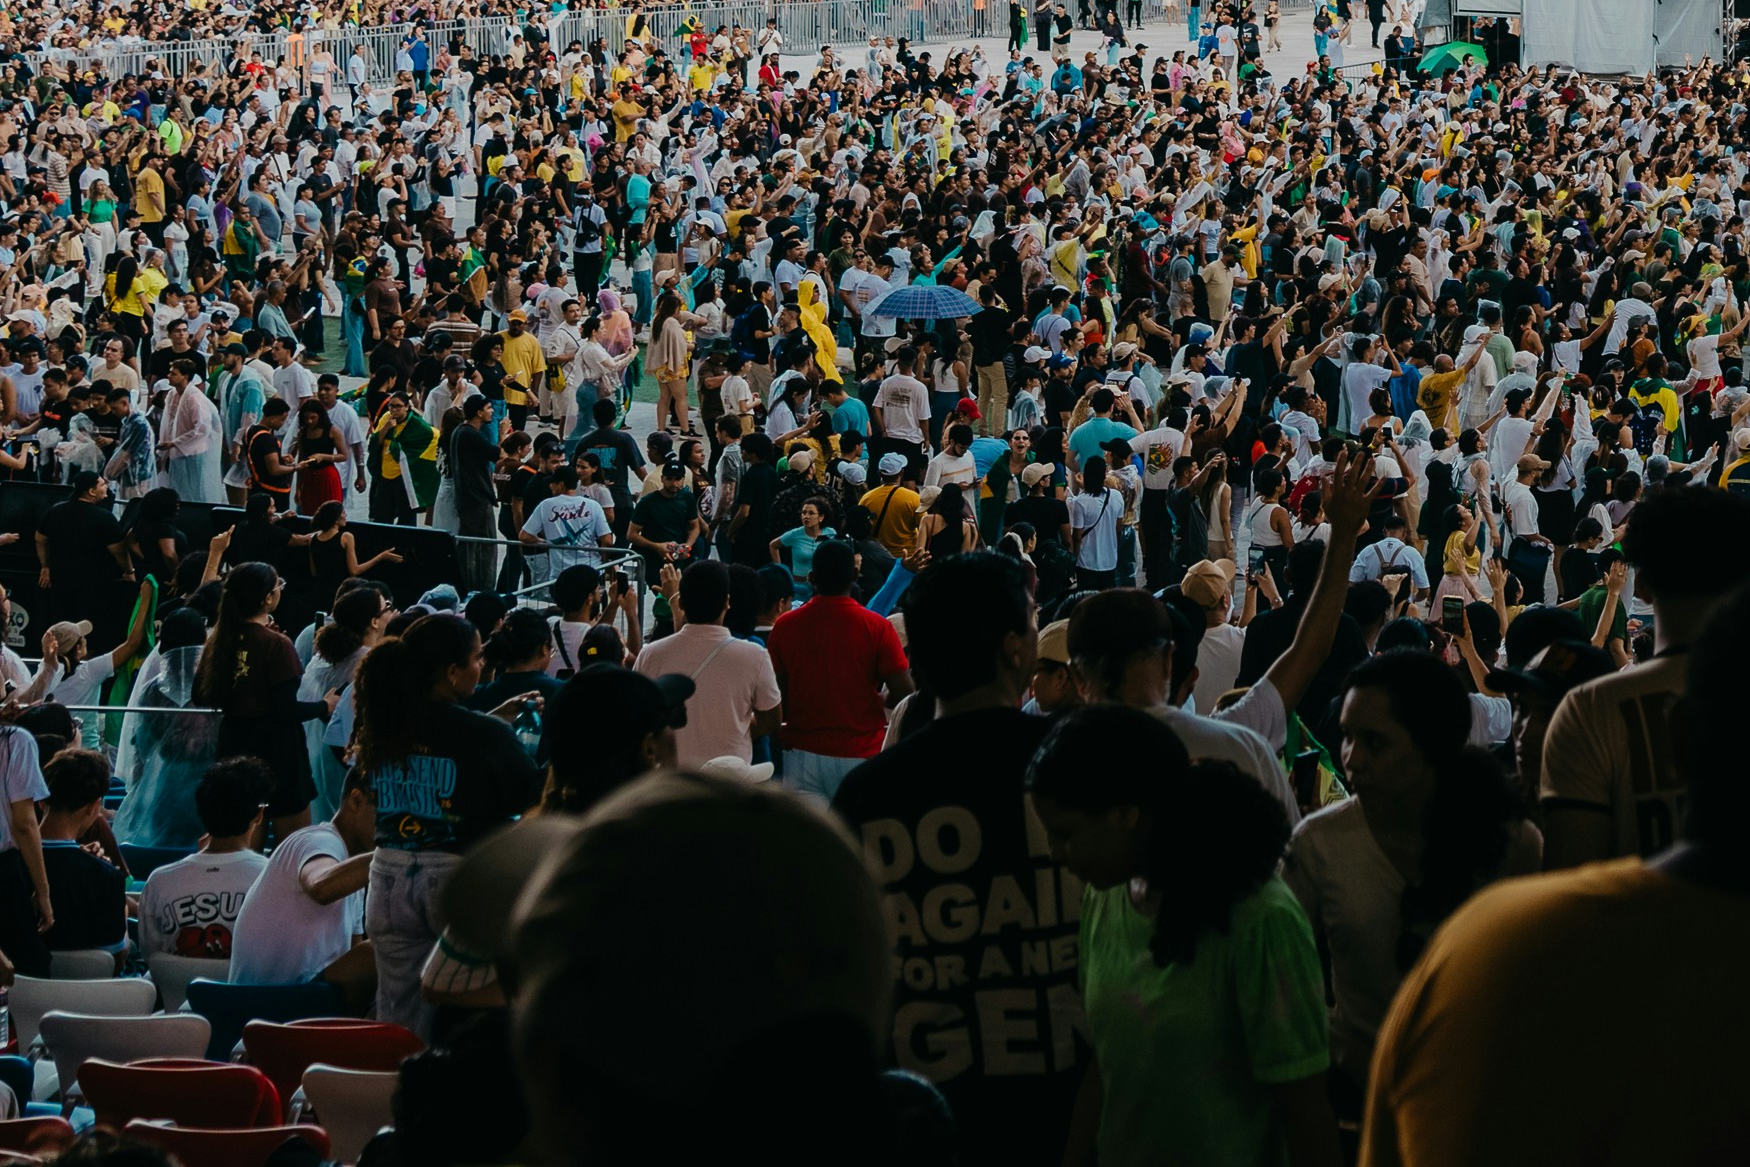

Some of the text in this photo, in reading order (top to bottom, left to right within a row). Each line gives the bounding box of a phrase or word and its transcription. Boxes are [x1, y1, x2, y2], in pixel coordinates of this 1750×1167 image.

[407, 754, 458, 799] SEND
[860, 804, 983, 886] DO
[162, 891, 246, 934] JESU
[978, 944, 1015, 980] A
[1021, 933, 1079, 978] NE
